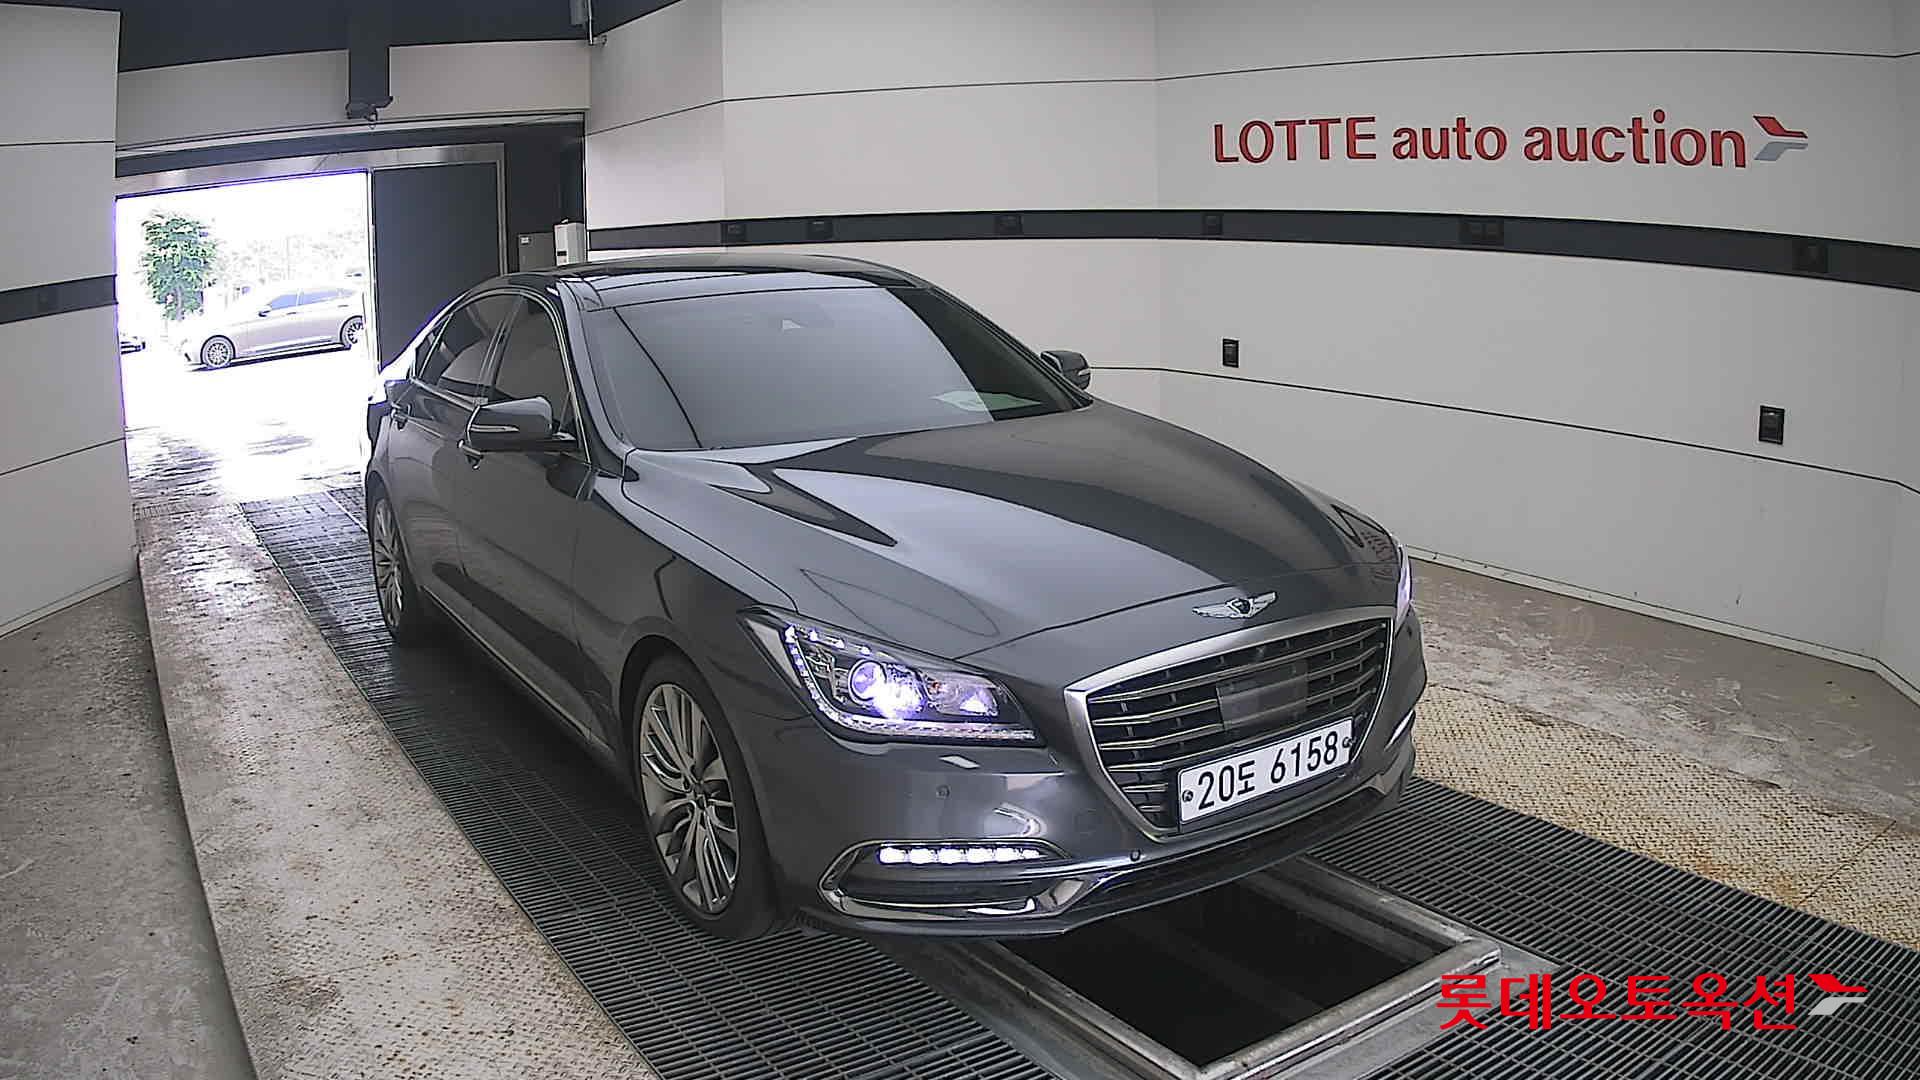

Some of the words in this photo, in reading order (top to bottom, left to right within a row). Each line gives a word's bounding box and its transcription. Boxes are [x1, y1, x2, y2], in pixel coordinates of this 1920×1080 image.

[1214, 116, 1377, 163] LOTTE
[1393, 117, 1506, 160] auto
[1524, 109, 1746, 168] auction
[1198, 760, 1255, 810] 20도
[1270, 731, 1338, 784] 6158
